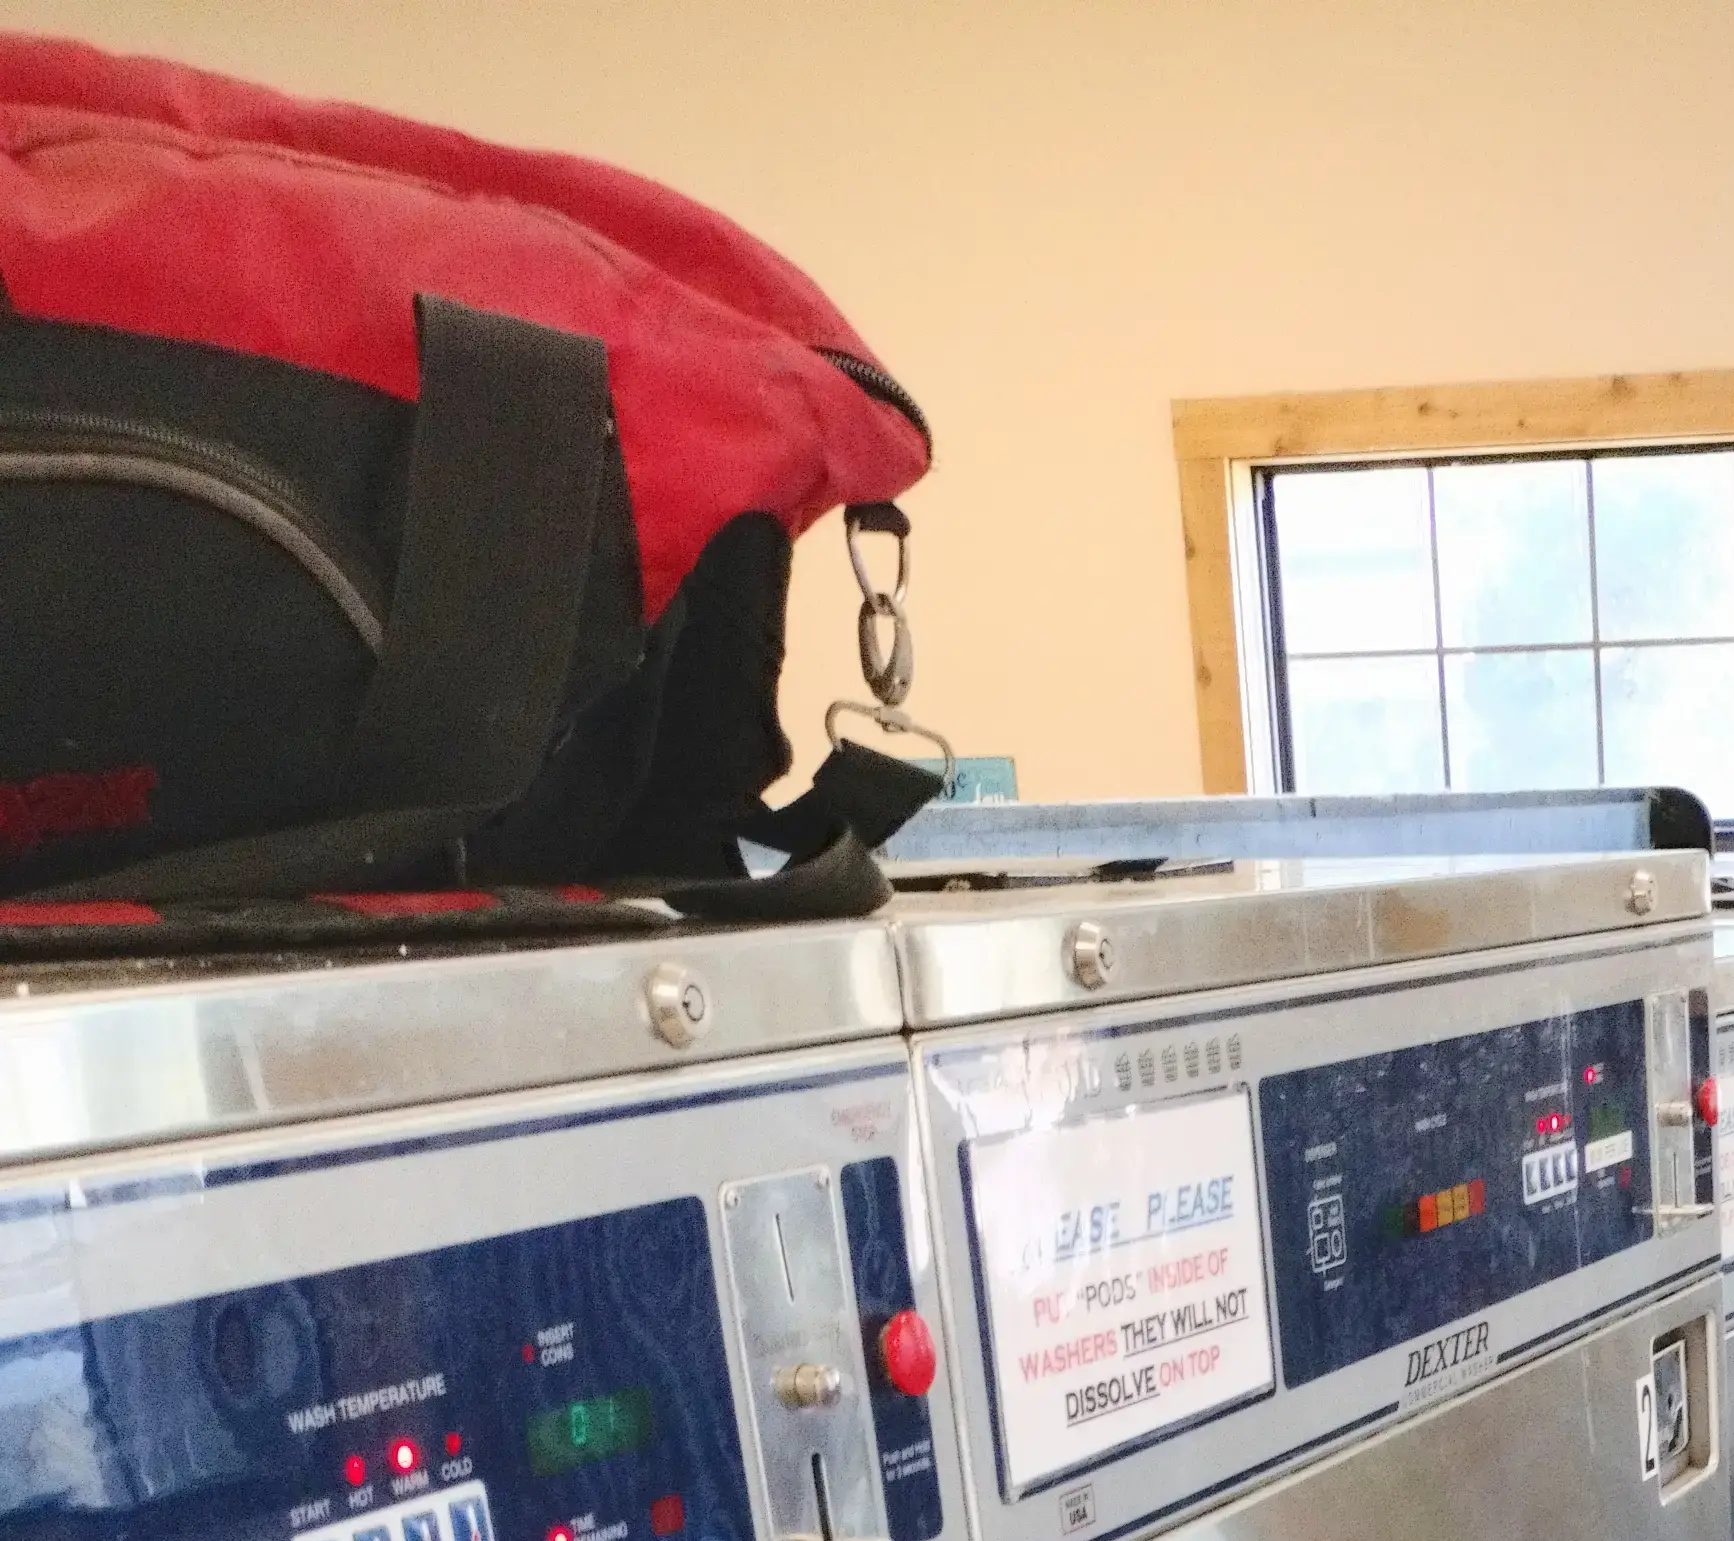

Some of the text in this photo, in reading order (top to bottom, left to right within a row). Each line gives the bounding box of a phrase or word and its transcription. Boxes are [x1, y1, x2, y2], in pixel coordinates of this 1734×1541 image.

[1146, 1174, 1235, 1232] PLEASE
[1147, 1254, 1205, 1295] INSIDE
[1207, 1246, 1229, 1277] OF
[1019, 1287, 1249, 1385] WASHERS THEY WILL NOT
[1403, 1319, 1490, 1388] DEXTER
[286, 1371, 449, 1436] WASH TEMPERATURE
[1064, 1344, 1221, 1423] DISSOLVE ON TOP
[1641, 1385, 1656, 1473] 2
[289, 1454, 474, 1530] START HOT WARM COLD
[1068, 1506, 1089, 1527] USA
